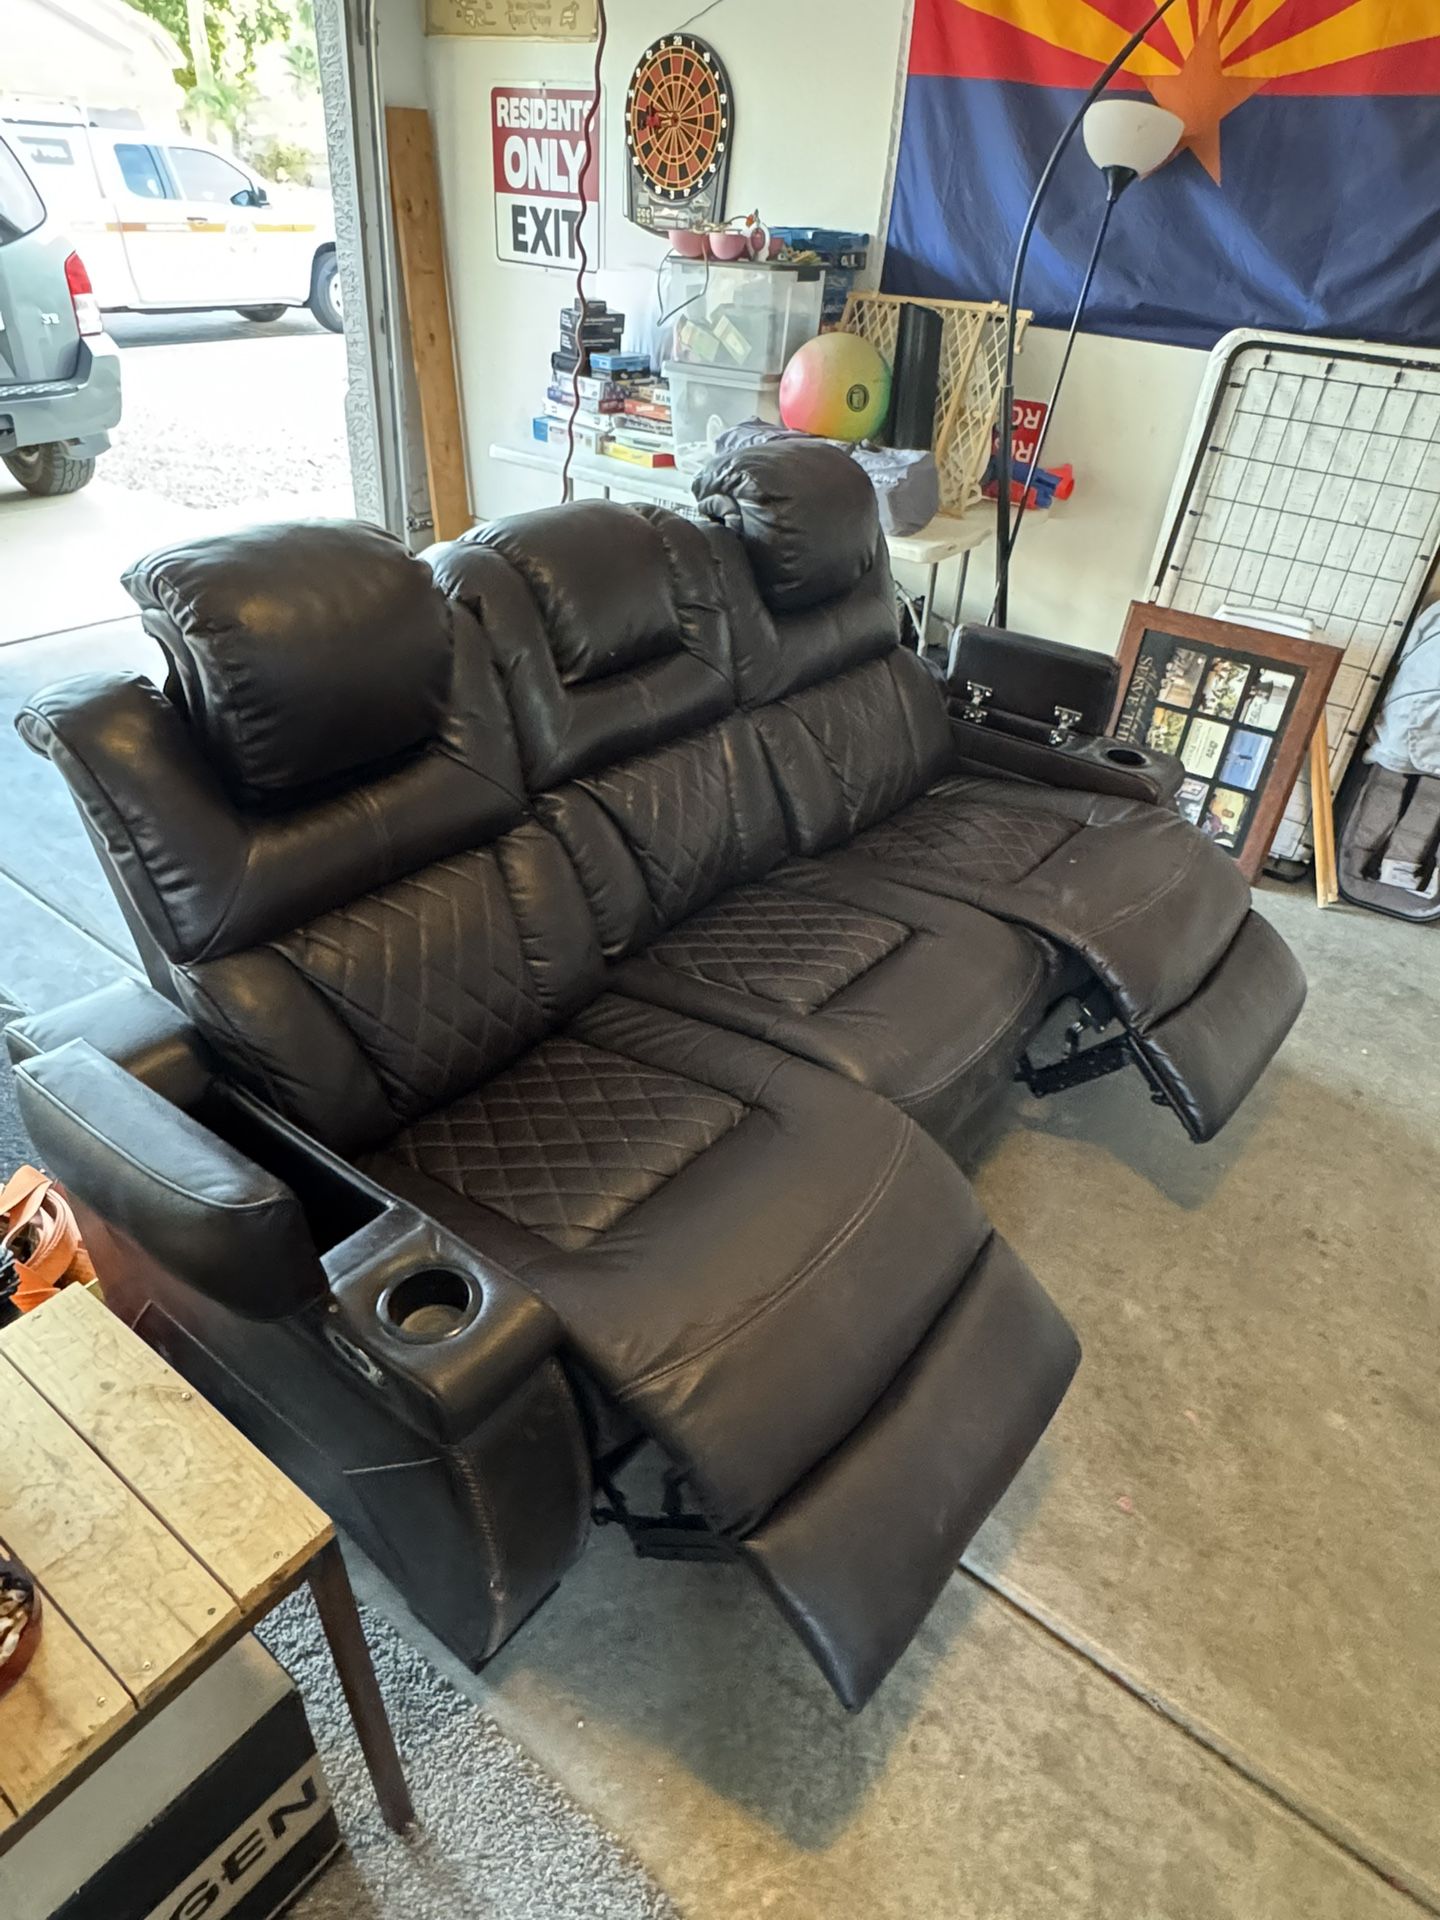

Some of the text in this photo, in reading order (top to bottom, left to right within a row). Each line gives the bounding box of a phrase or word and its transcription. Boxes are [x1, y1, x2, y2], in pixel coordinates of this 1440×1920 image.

[673, 35, 683, 46] 20
[690, 40, 696, 50] 1
[713, 70, 720, 81] 4
[503, 135, 588, 194] ONLY
[511, 203, 582, 260] EXIT
[1126, 655, 1153, 706] SERVE
